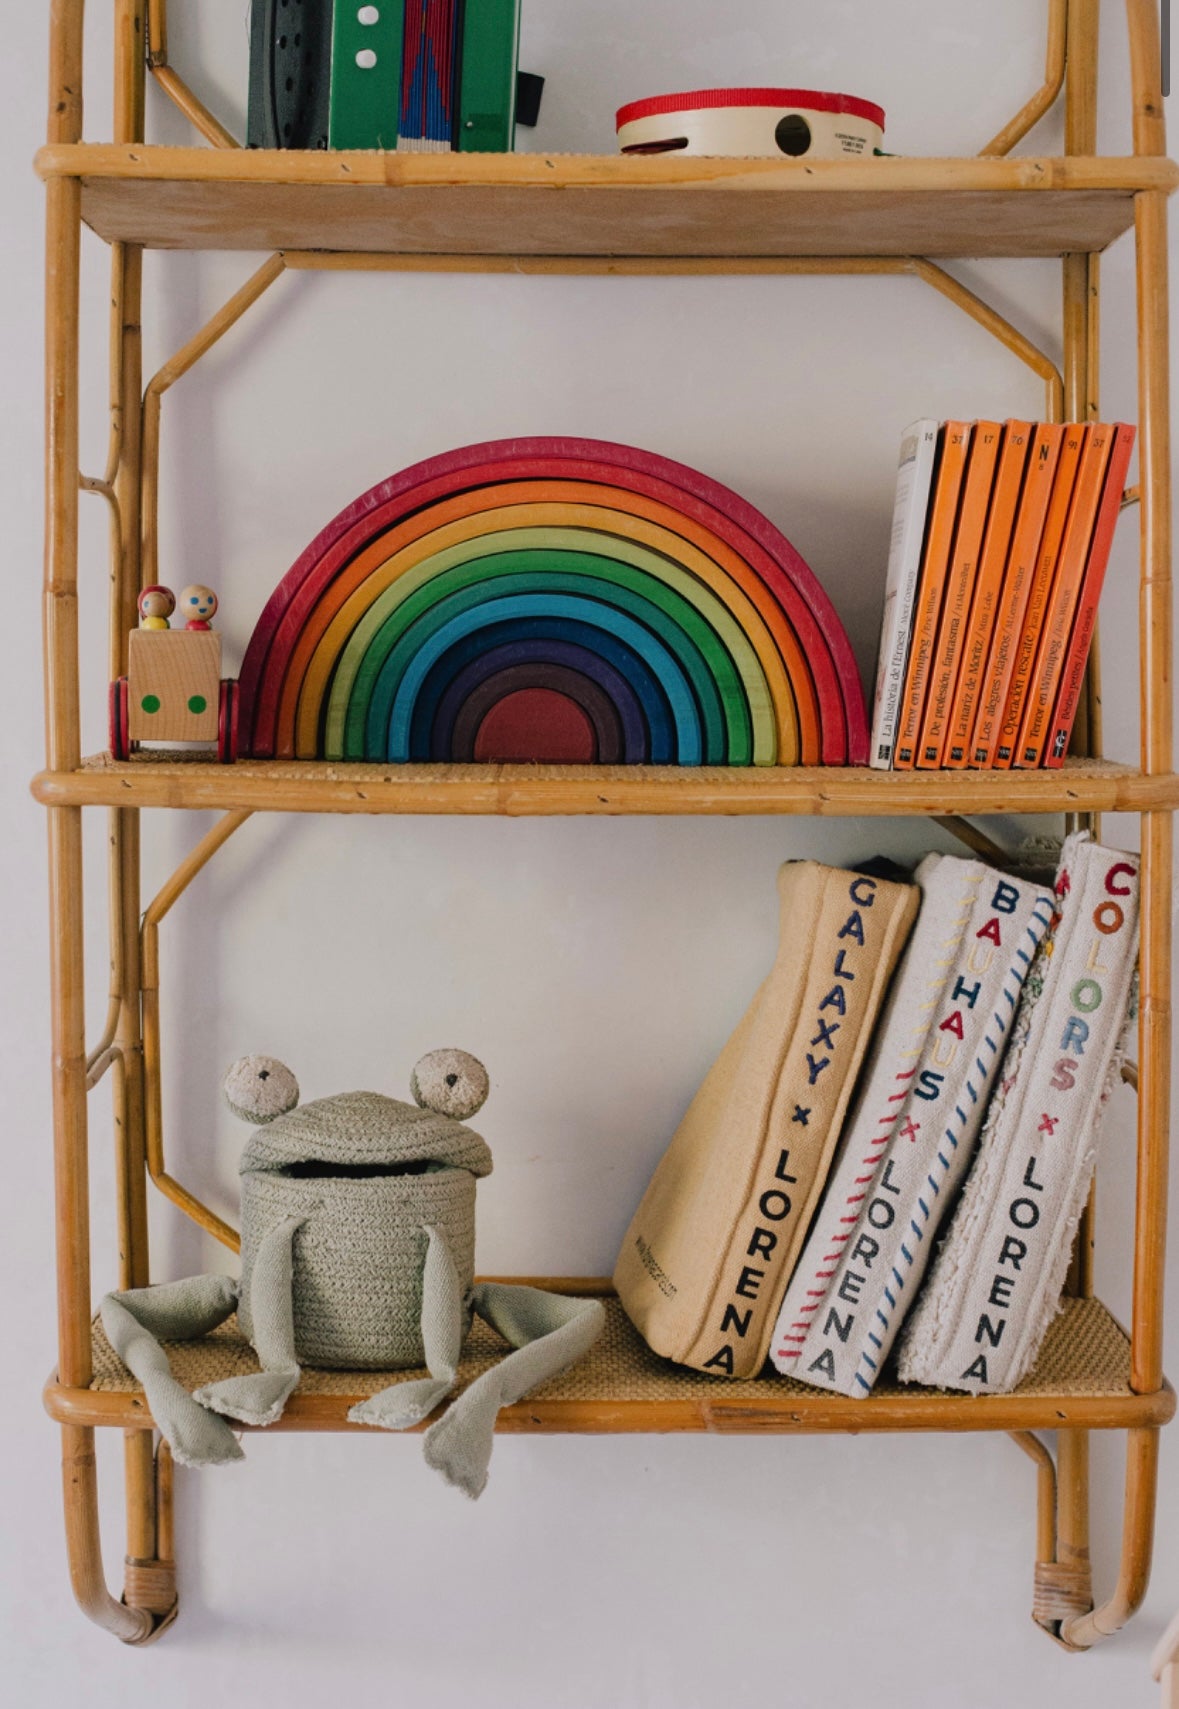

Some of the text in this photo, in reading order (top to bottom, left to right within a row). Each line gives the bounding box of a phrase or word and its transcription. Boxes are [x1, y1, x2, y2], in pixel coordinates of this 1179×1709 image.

[911, 639, 930, 691] Winnipeg
[969, 640, 984, 675] Moritz
[1017, 634, 1034, 676] rescate
[1041, 640, 1061, 690] Winnipeg
[930, 721, 941, 737] De
[943, 618, 960, 667] fantasma
[965, 677, 977, 691] de
[986, 679, 1002, 717] alegres
[882, 724, 893, 737] La
[890, 668, 901, 681] de
[911, 693, 919, 706] en
[961, 693, 973, 722] nariz
[1039, 693, 1048, 706] en
[904, 708, 916, 738] Terror
[956, 723, 968, 738] La
[980, 721, 993, 742] Los
[1031, 708, 1044, 738] Terror
[806, 878, 877, 1085] GALAXY
[913, 880, 1021, 1102] BAUHAUS
[1051, 863, 1138, 1091] COLORS
[703, 1150, 791, 1375] LORENA
[808, 1159, 901, 1382] LORENA
[963, 1157, 1044, 1384] LORENA
